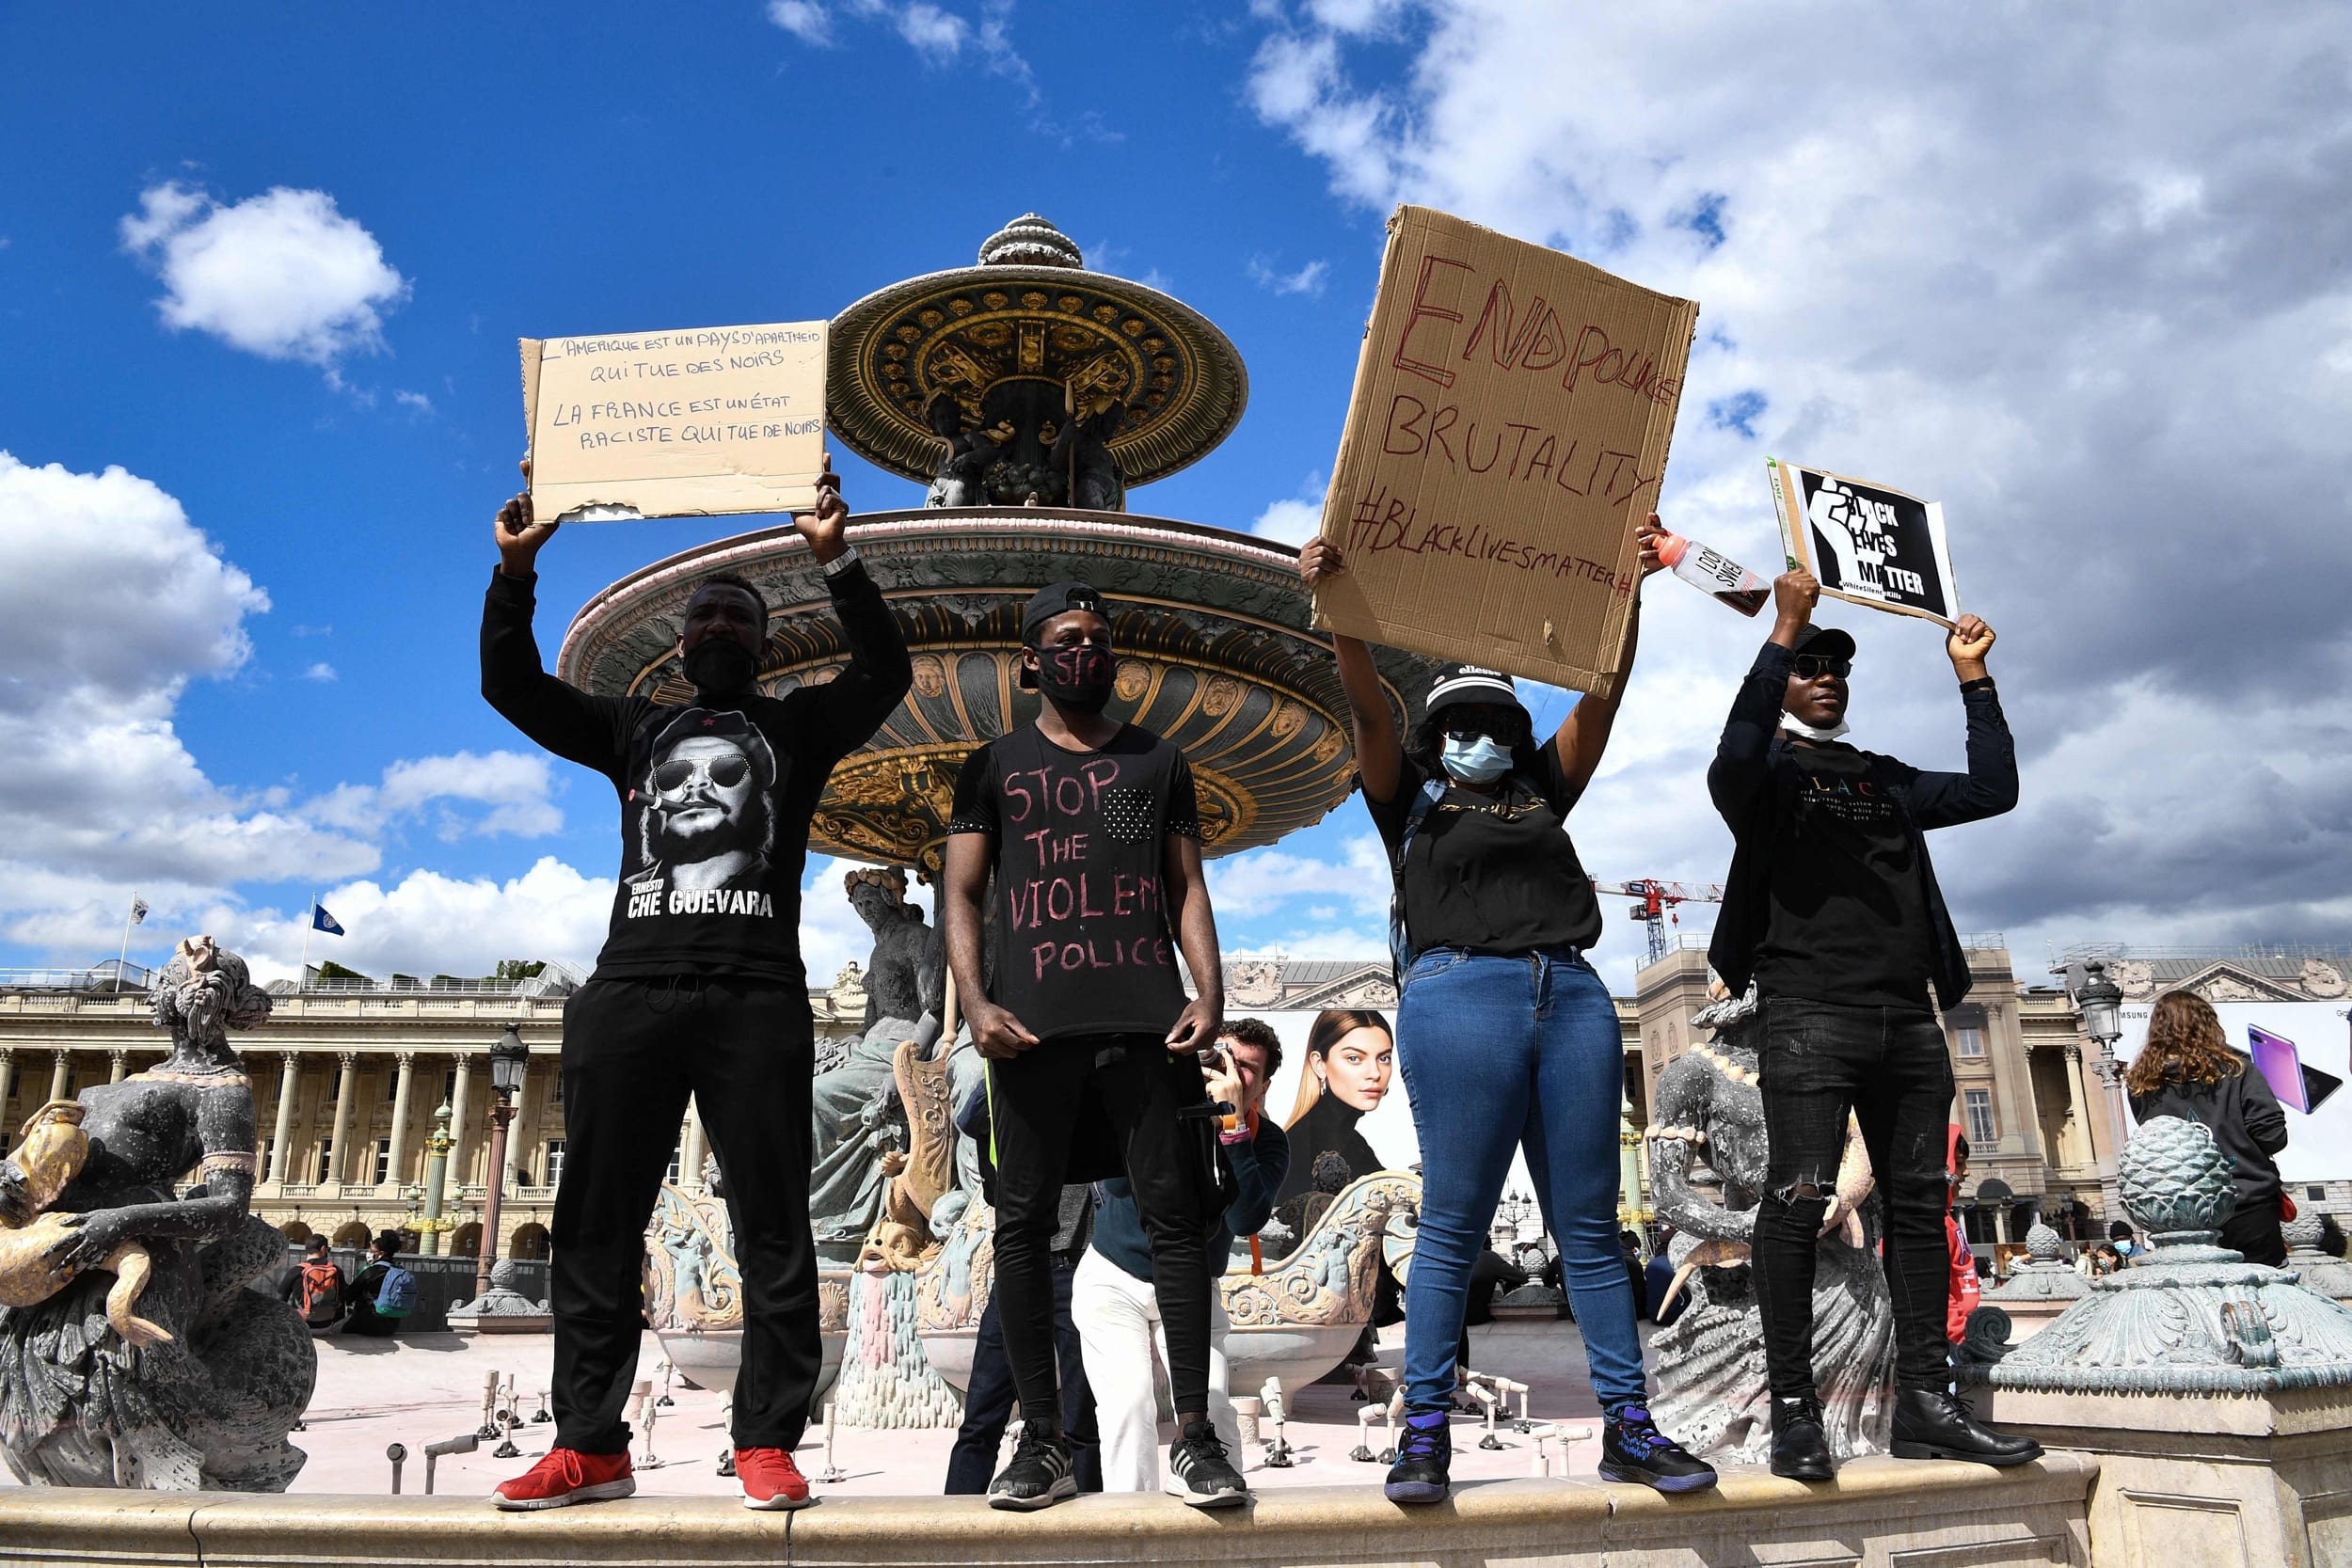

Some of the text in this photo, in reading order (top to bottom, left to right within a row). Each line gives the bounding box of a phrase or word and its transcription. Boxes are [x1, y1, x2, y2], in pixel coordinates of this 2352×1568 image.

[1392, 255, 1567, 388] END
[644, 337, 671, 350] EST
[675, 336, 693, 346] UN
[697, 331, 740, 354] PAYS
[591, 350, 784, 383] QUI TUE DES NOIRS
[553, 392, 791, 427] LA FRANCE EST UN ÉTAT
[580, 419, 821, 450] RACISTE QUI TUE DE NOIRS
[1382, 394, 1657, 507] BRUTALITY
[1848, 496, 1899, 527] BLACK
[1698, 546, 1724, 570] DON
[1851, 527, 1898, 557] LIVES
[1715, 559, 1744, 588] SWEA
[1857, 560, 1925, 595] MATTER
[1003, 759, 1120, 824] STOP
[1024, 828, 1089, 870] THE
[631, 878, 664, 895] ERNESTO
[1010, 872, 1158, 933] VIOLEN
[628, 889, 773, 919] CHE GUEVARA
[1031, 937, 1170, 984] POLICE
[2120, 1011, 2148, 1020] MSUNG
